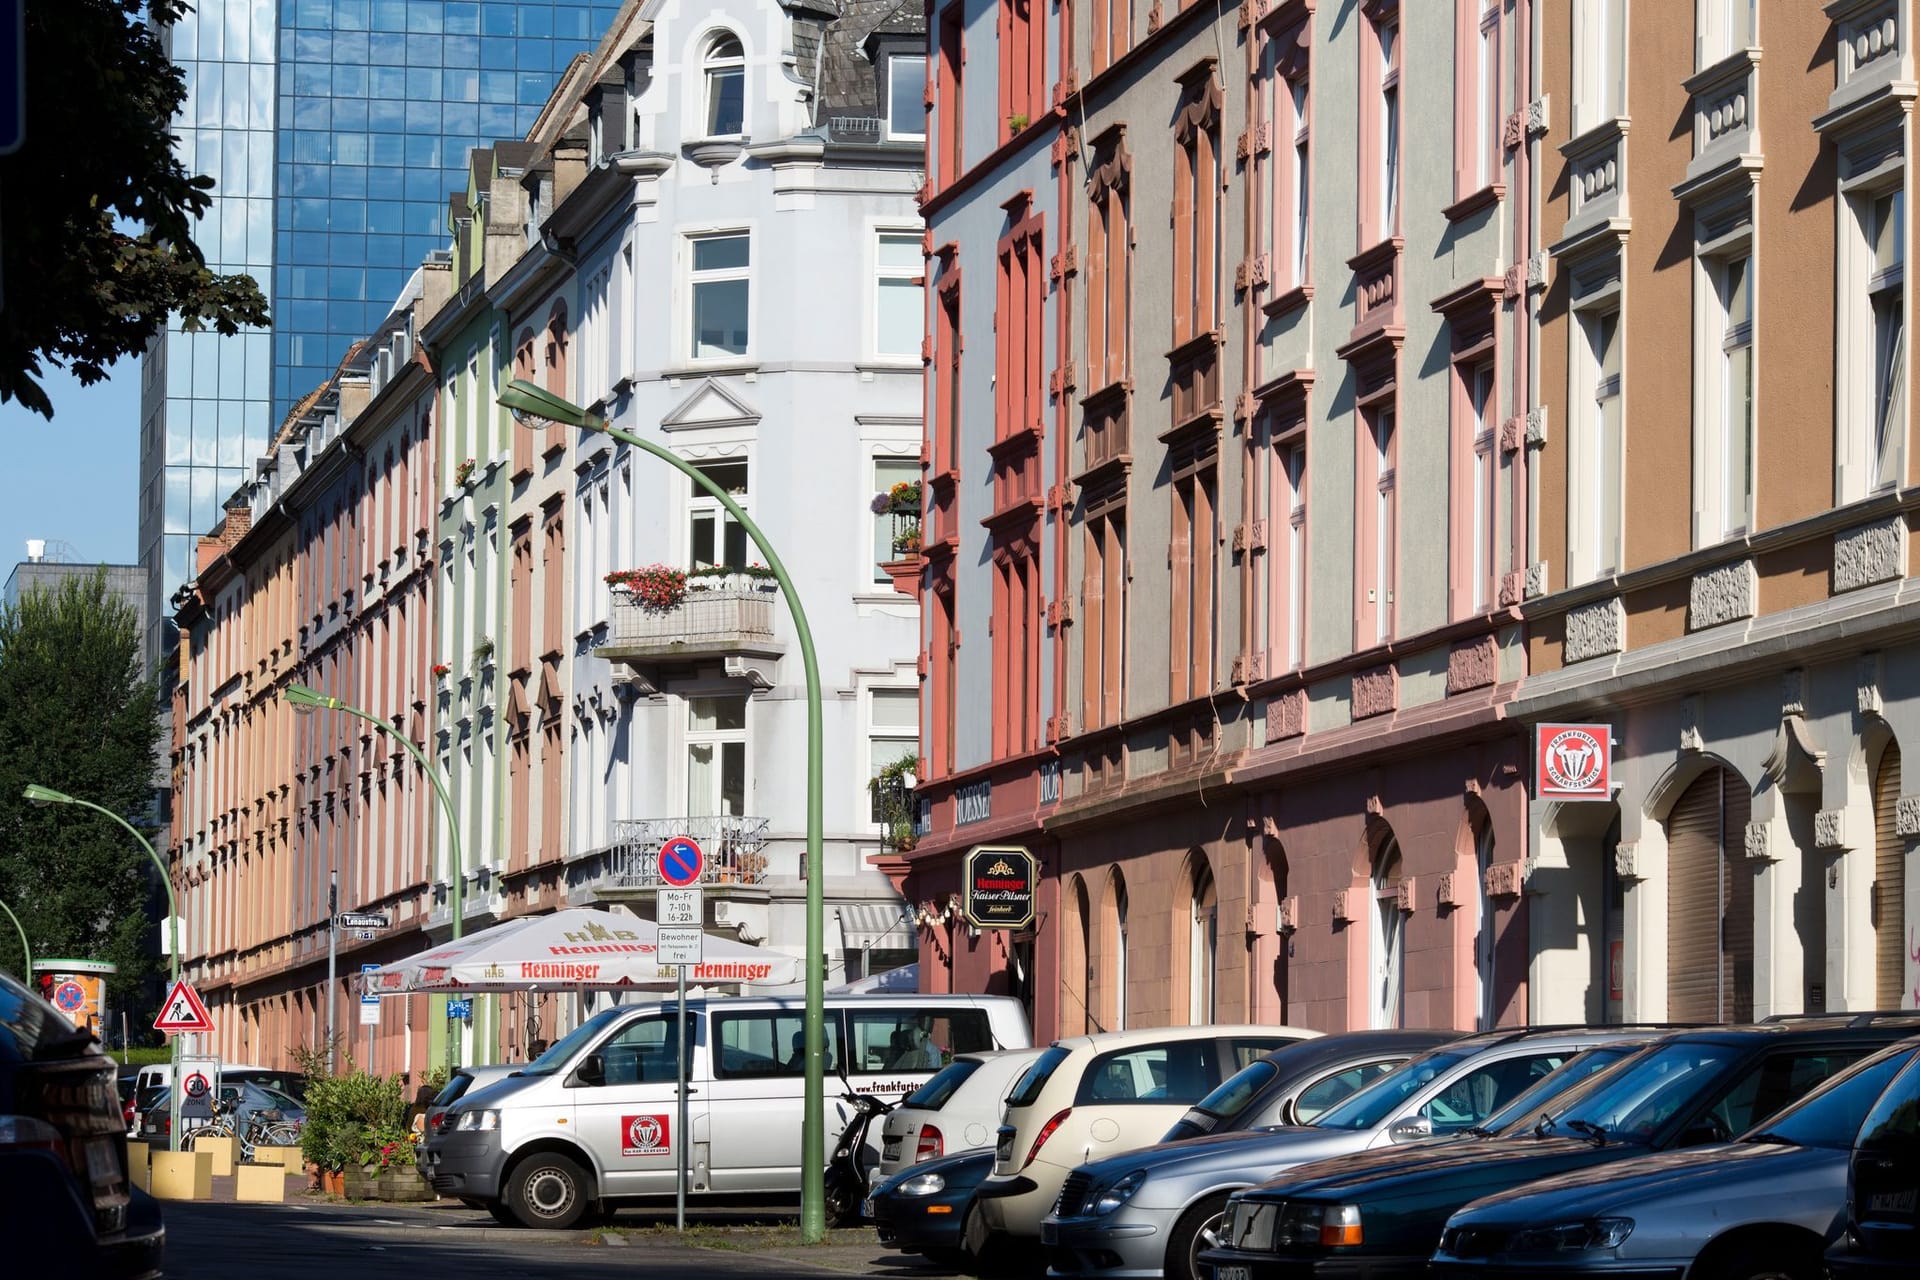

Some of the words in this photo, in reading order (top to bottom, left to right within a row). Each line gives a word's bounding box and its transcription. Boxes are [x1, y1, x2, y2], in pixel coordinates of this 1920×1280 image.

[1551, 731, 1598, 749] FRANKFURTER
[976, 878, 1026, 891] Henninger
[667, 892, 693, 901] Mo-Fr
[971, 890, 1001, 901] Kaiser
[1000, 890, 1031, 901] Pilsner
[667, 913, 693, 921] 16-22h
[660, 933, 698, 941] Bewohner
[549, 943, 657, 955] Henning
[673, 952, 687, 960] frei
[521, 961, 600, 981] Henninger
[693, 961, 772, 981] Henninger
[189, 1080, 204, 1092] 30
